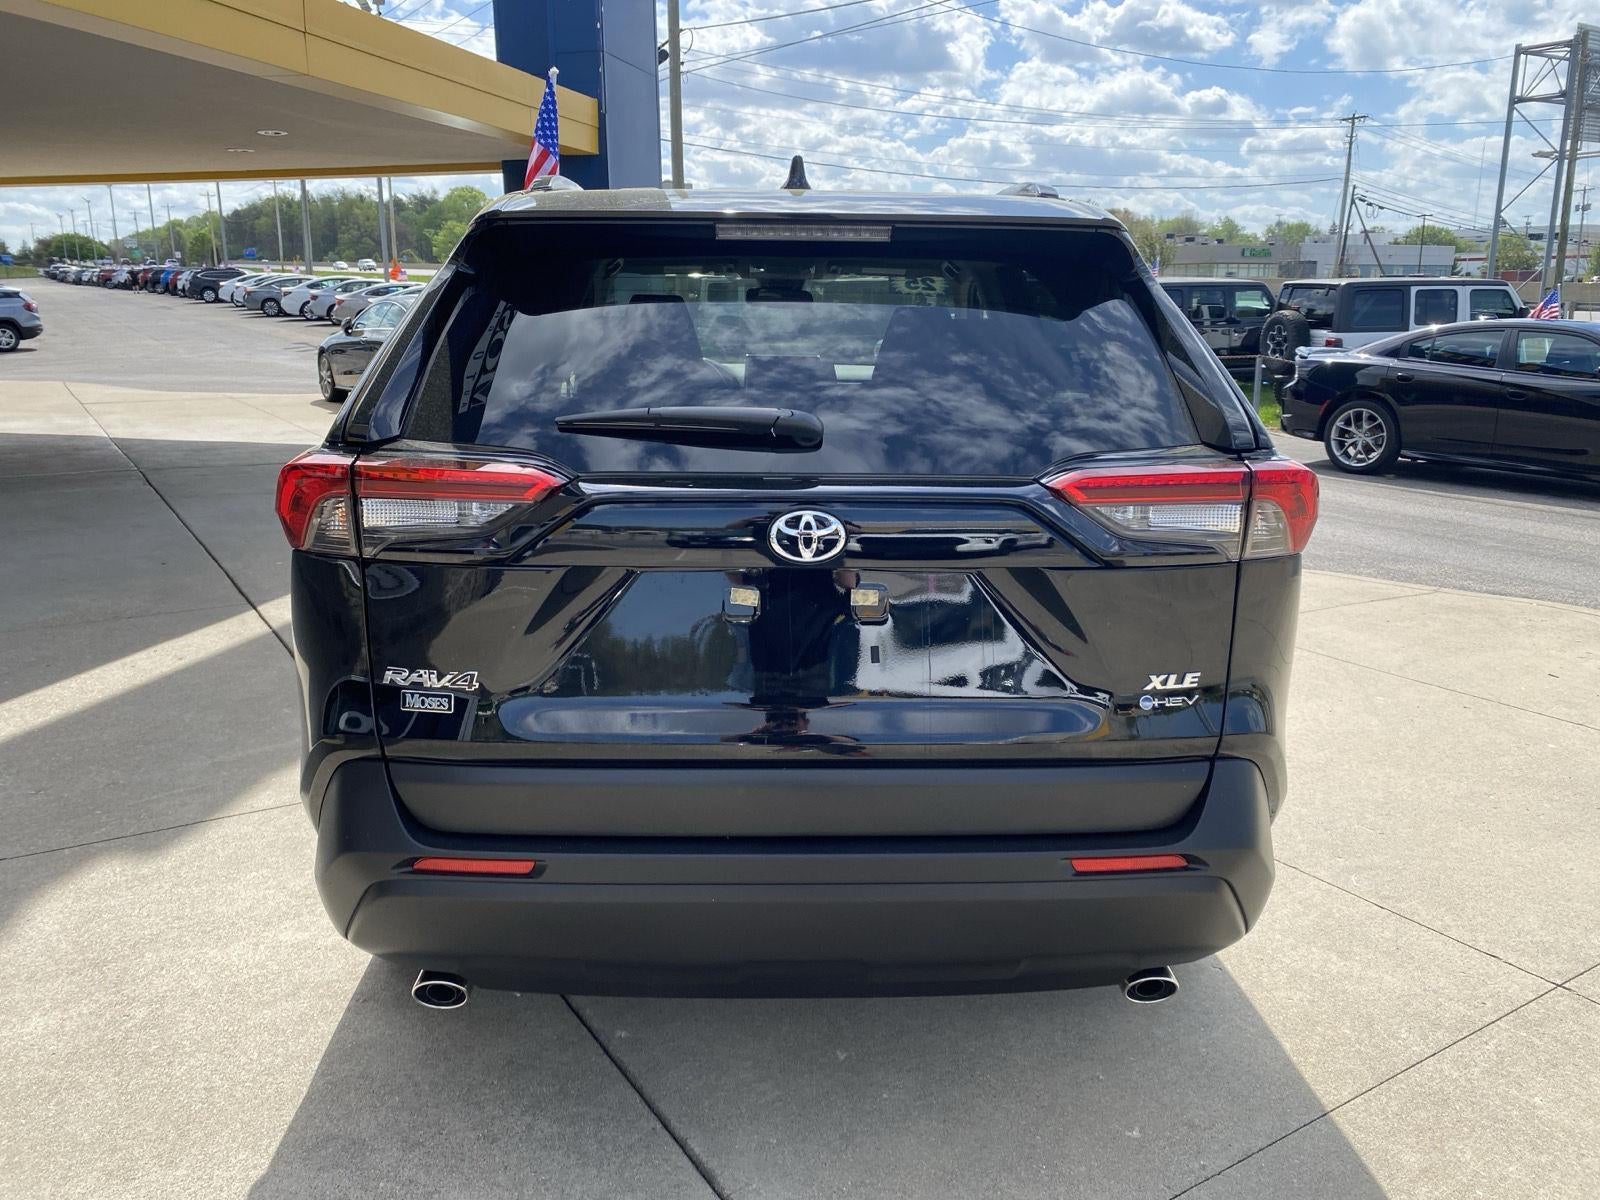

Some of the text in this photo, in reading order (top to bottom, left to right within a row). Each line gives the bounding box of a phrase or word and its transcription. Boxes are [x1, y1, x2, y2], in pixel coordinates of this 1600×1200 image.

[382, 666, 480, 691] RAV4
[1143, 671, 1202, 691] XLE
[405, 693, 449, 710] MOSES
[1152, 694, 1199, 708] HEV
